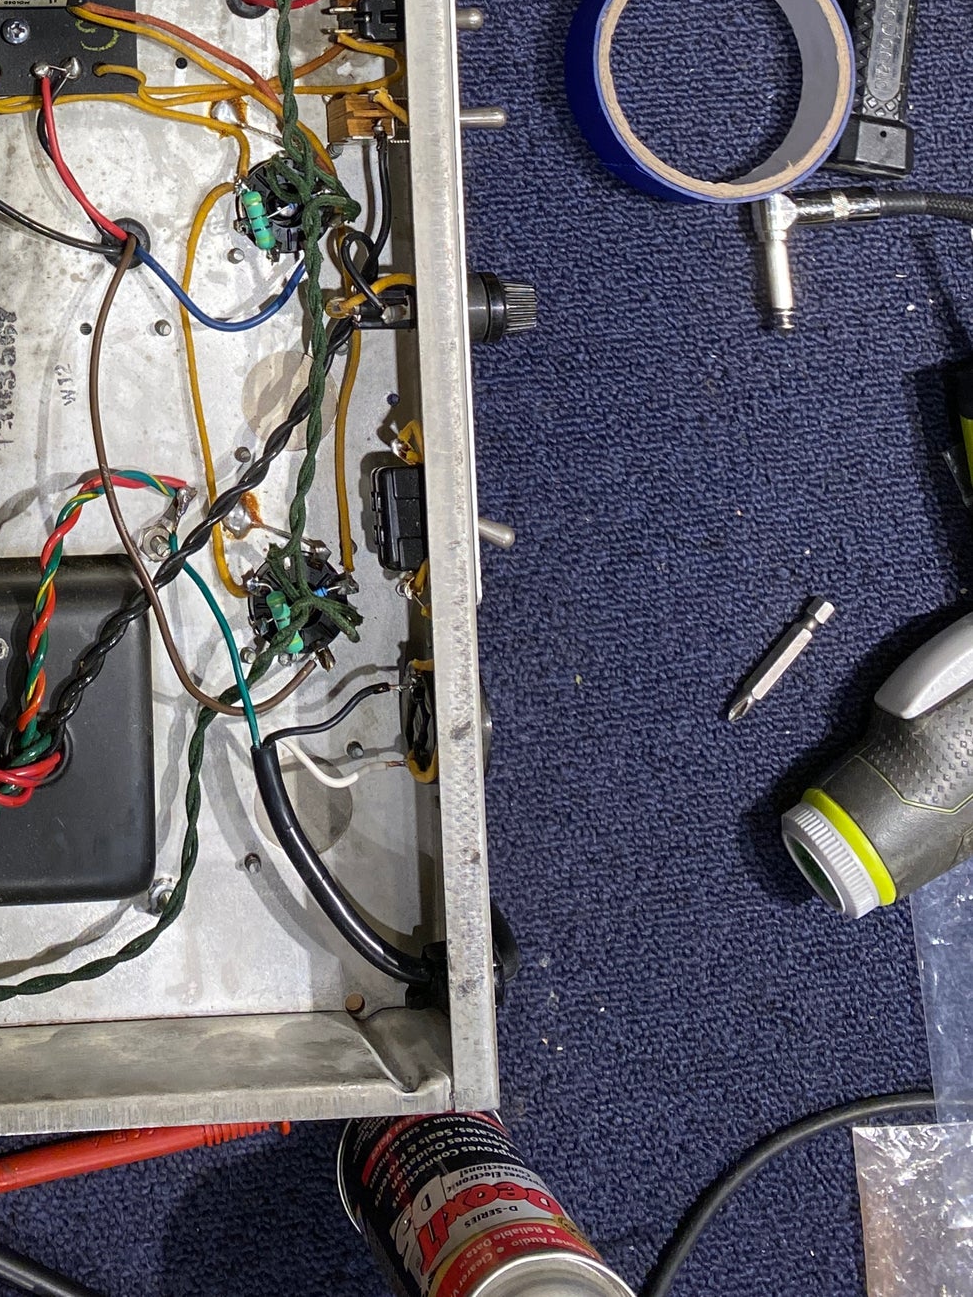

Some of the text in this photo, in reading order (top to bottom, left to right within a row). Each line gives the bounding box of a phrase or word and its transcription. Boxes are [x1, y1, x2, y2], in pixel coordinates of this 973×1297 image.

[433, 1115, 466, 1124] Action
[401, 1126, 420, 1141] Safe
[418, 1128, 454, 1145] Seals
[389, 1140, 400, 1152] on
[406, 1144, 417, 1153] &
[391, 1142, 445, 1189] Oxidation
[374, 1152, 407, 1207] Protects
[392, 1148, 459, 1209] Connections
[446, 1171, 501, 1193] Electronic
[464, 1205, 519, 1228] D-SERIES
[493, 1225, 544, 1241] Reliable
[511, 1236, 548, 1247] Audio
